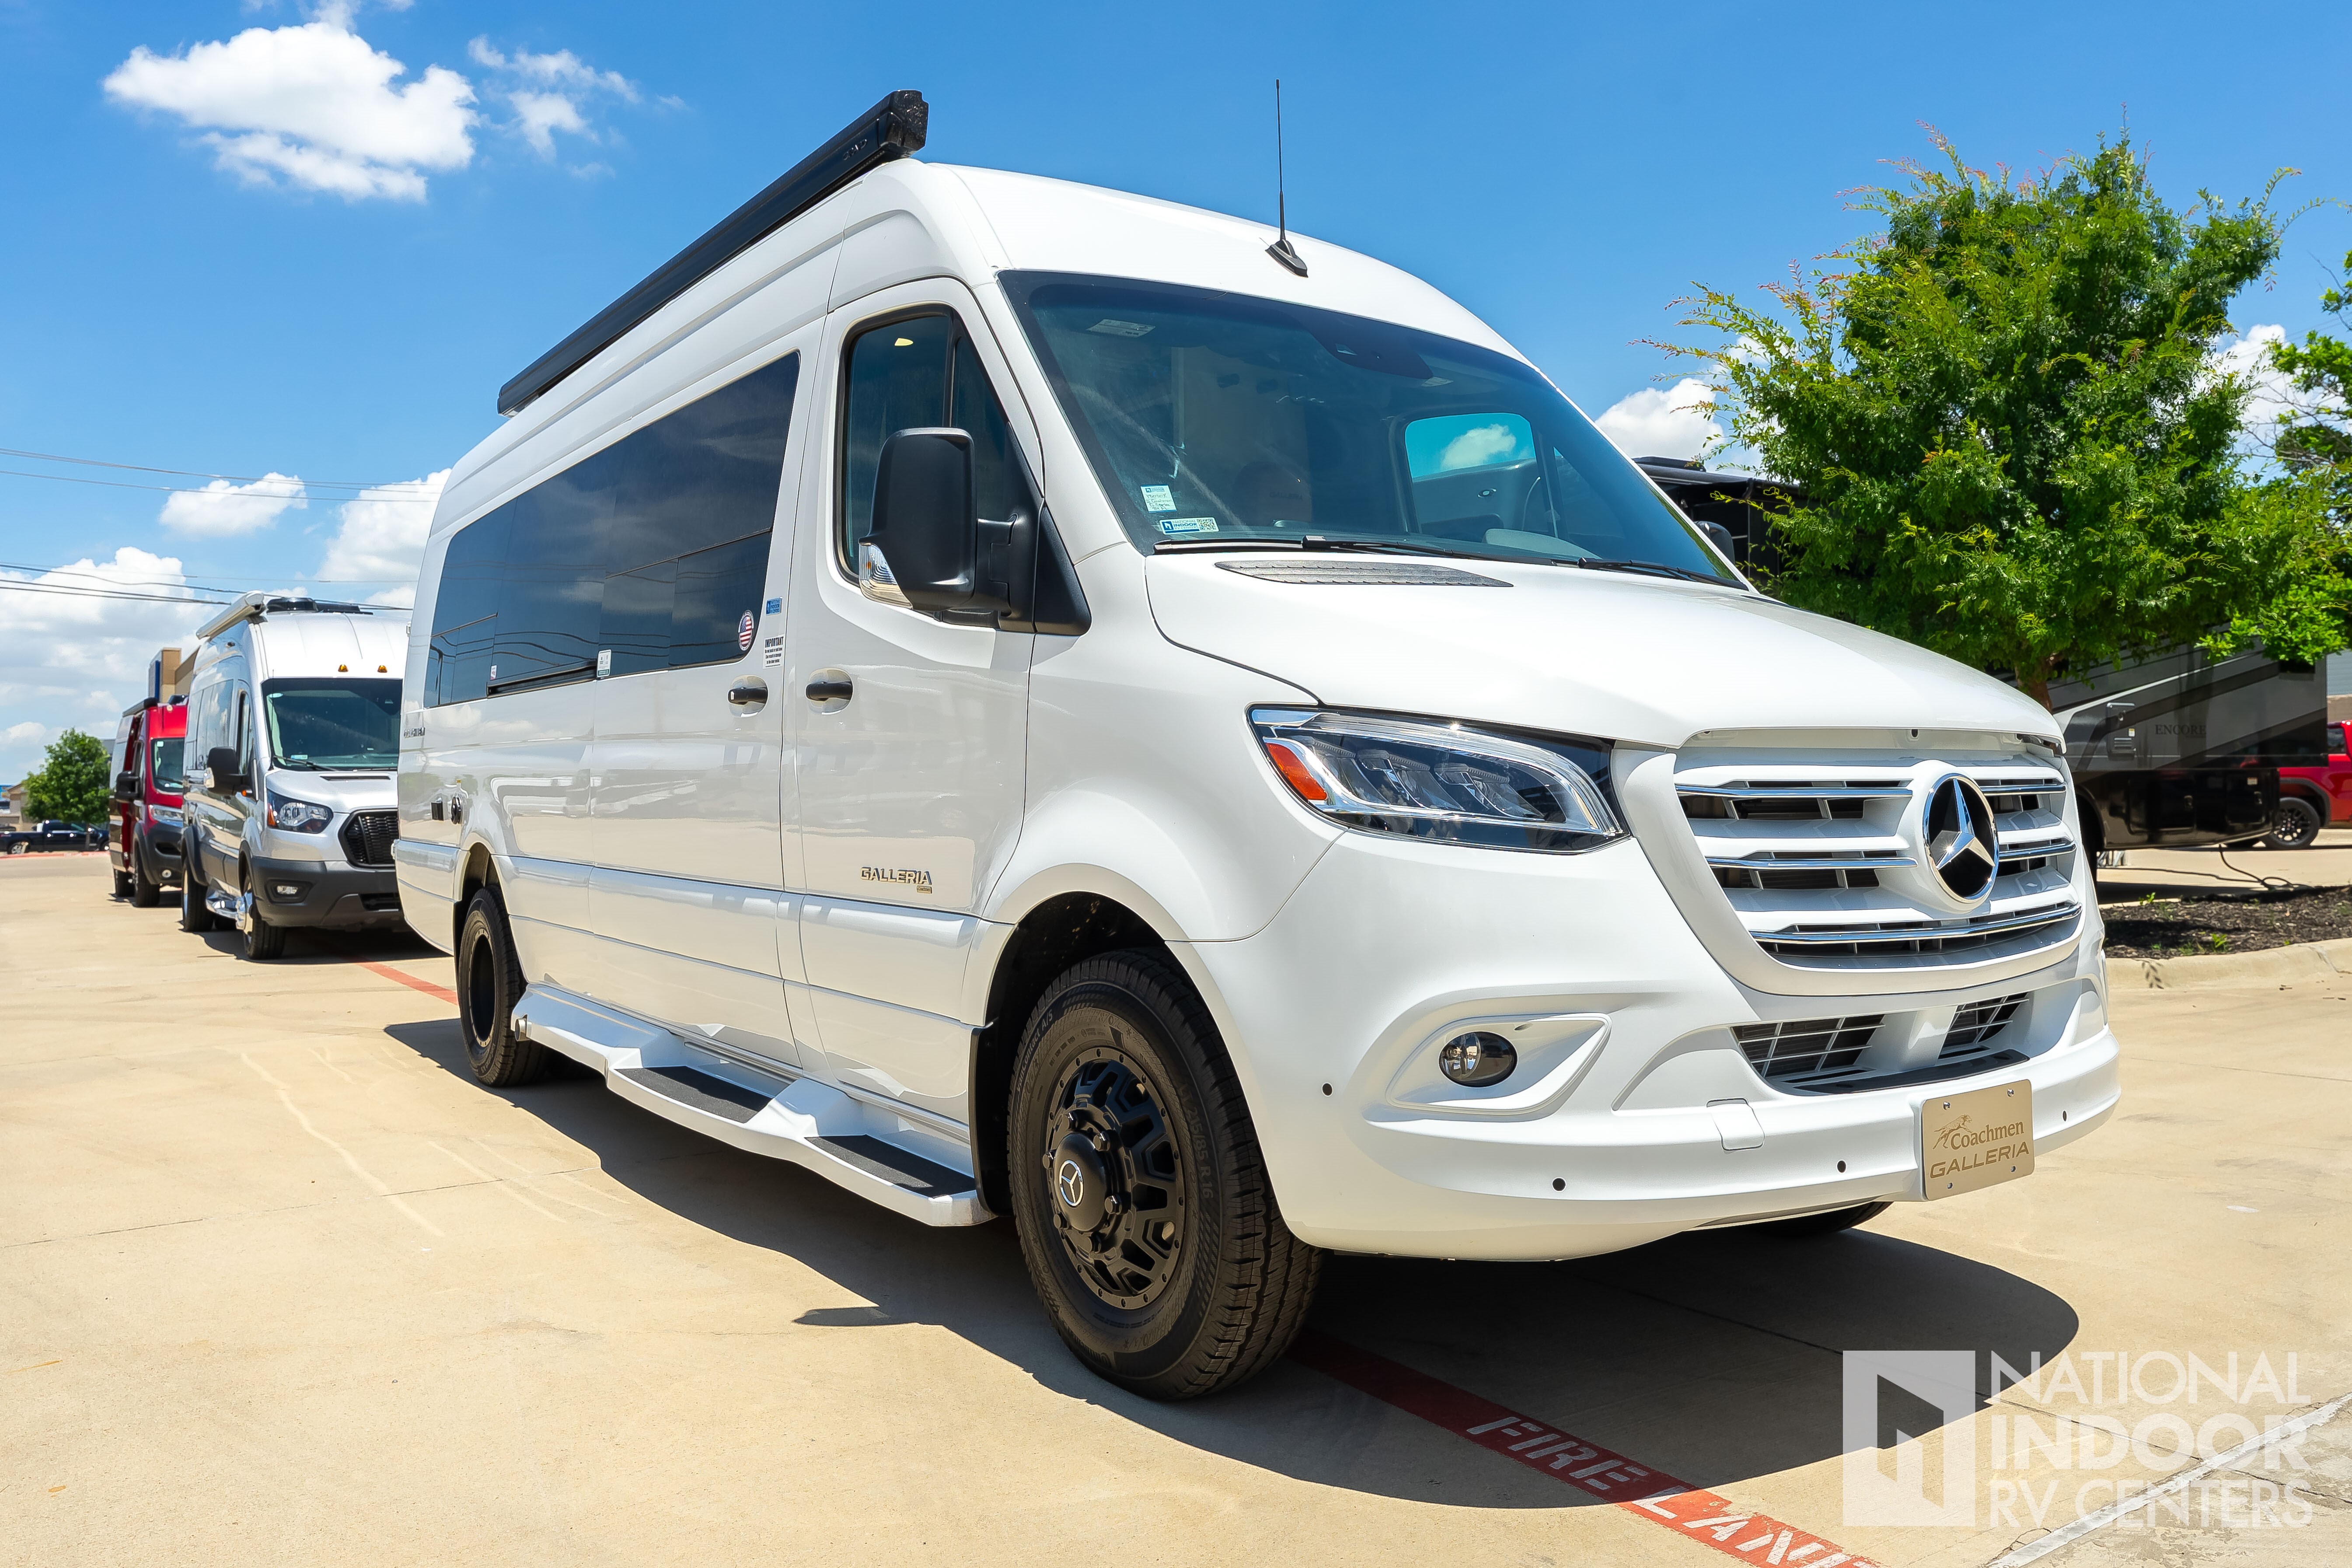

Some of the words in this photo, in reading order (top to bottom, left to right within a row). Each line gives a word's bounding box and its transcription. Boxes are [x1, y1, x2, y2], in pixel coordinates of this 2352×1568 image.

[765, 636, 784, 647] IMPORTANT
[2154, 724, 2207, 735] ENCORE
[860, 866, 932, 885] GALLERIA
[1041, 1009, 1053, 1031] A/S
[1950, 1121, 2024, 1150] Coachmen
[1930, 1141, 2030, 1179] GALLERIA
[1200, 1165, 1211, 1177] R
[1201, 1182, 1214, 1199] 16
[1466, 1416, 1651, 1490] FIRE
